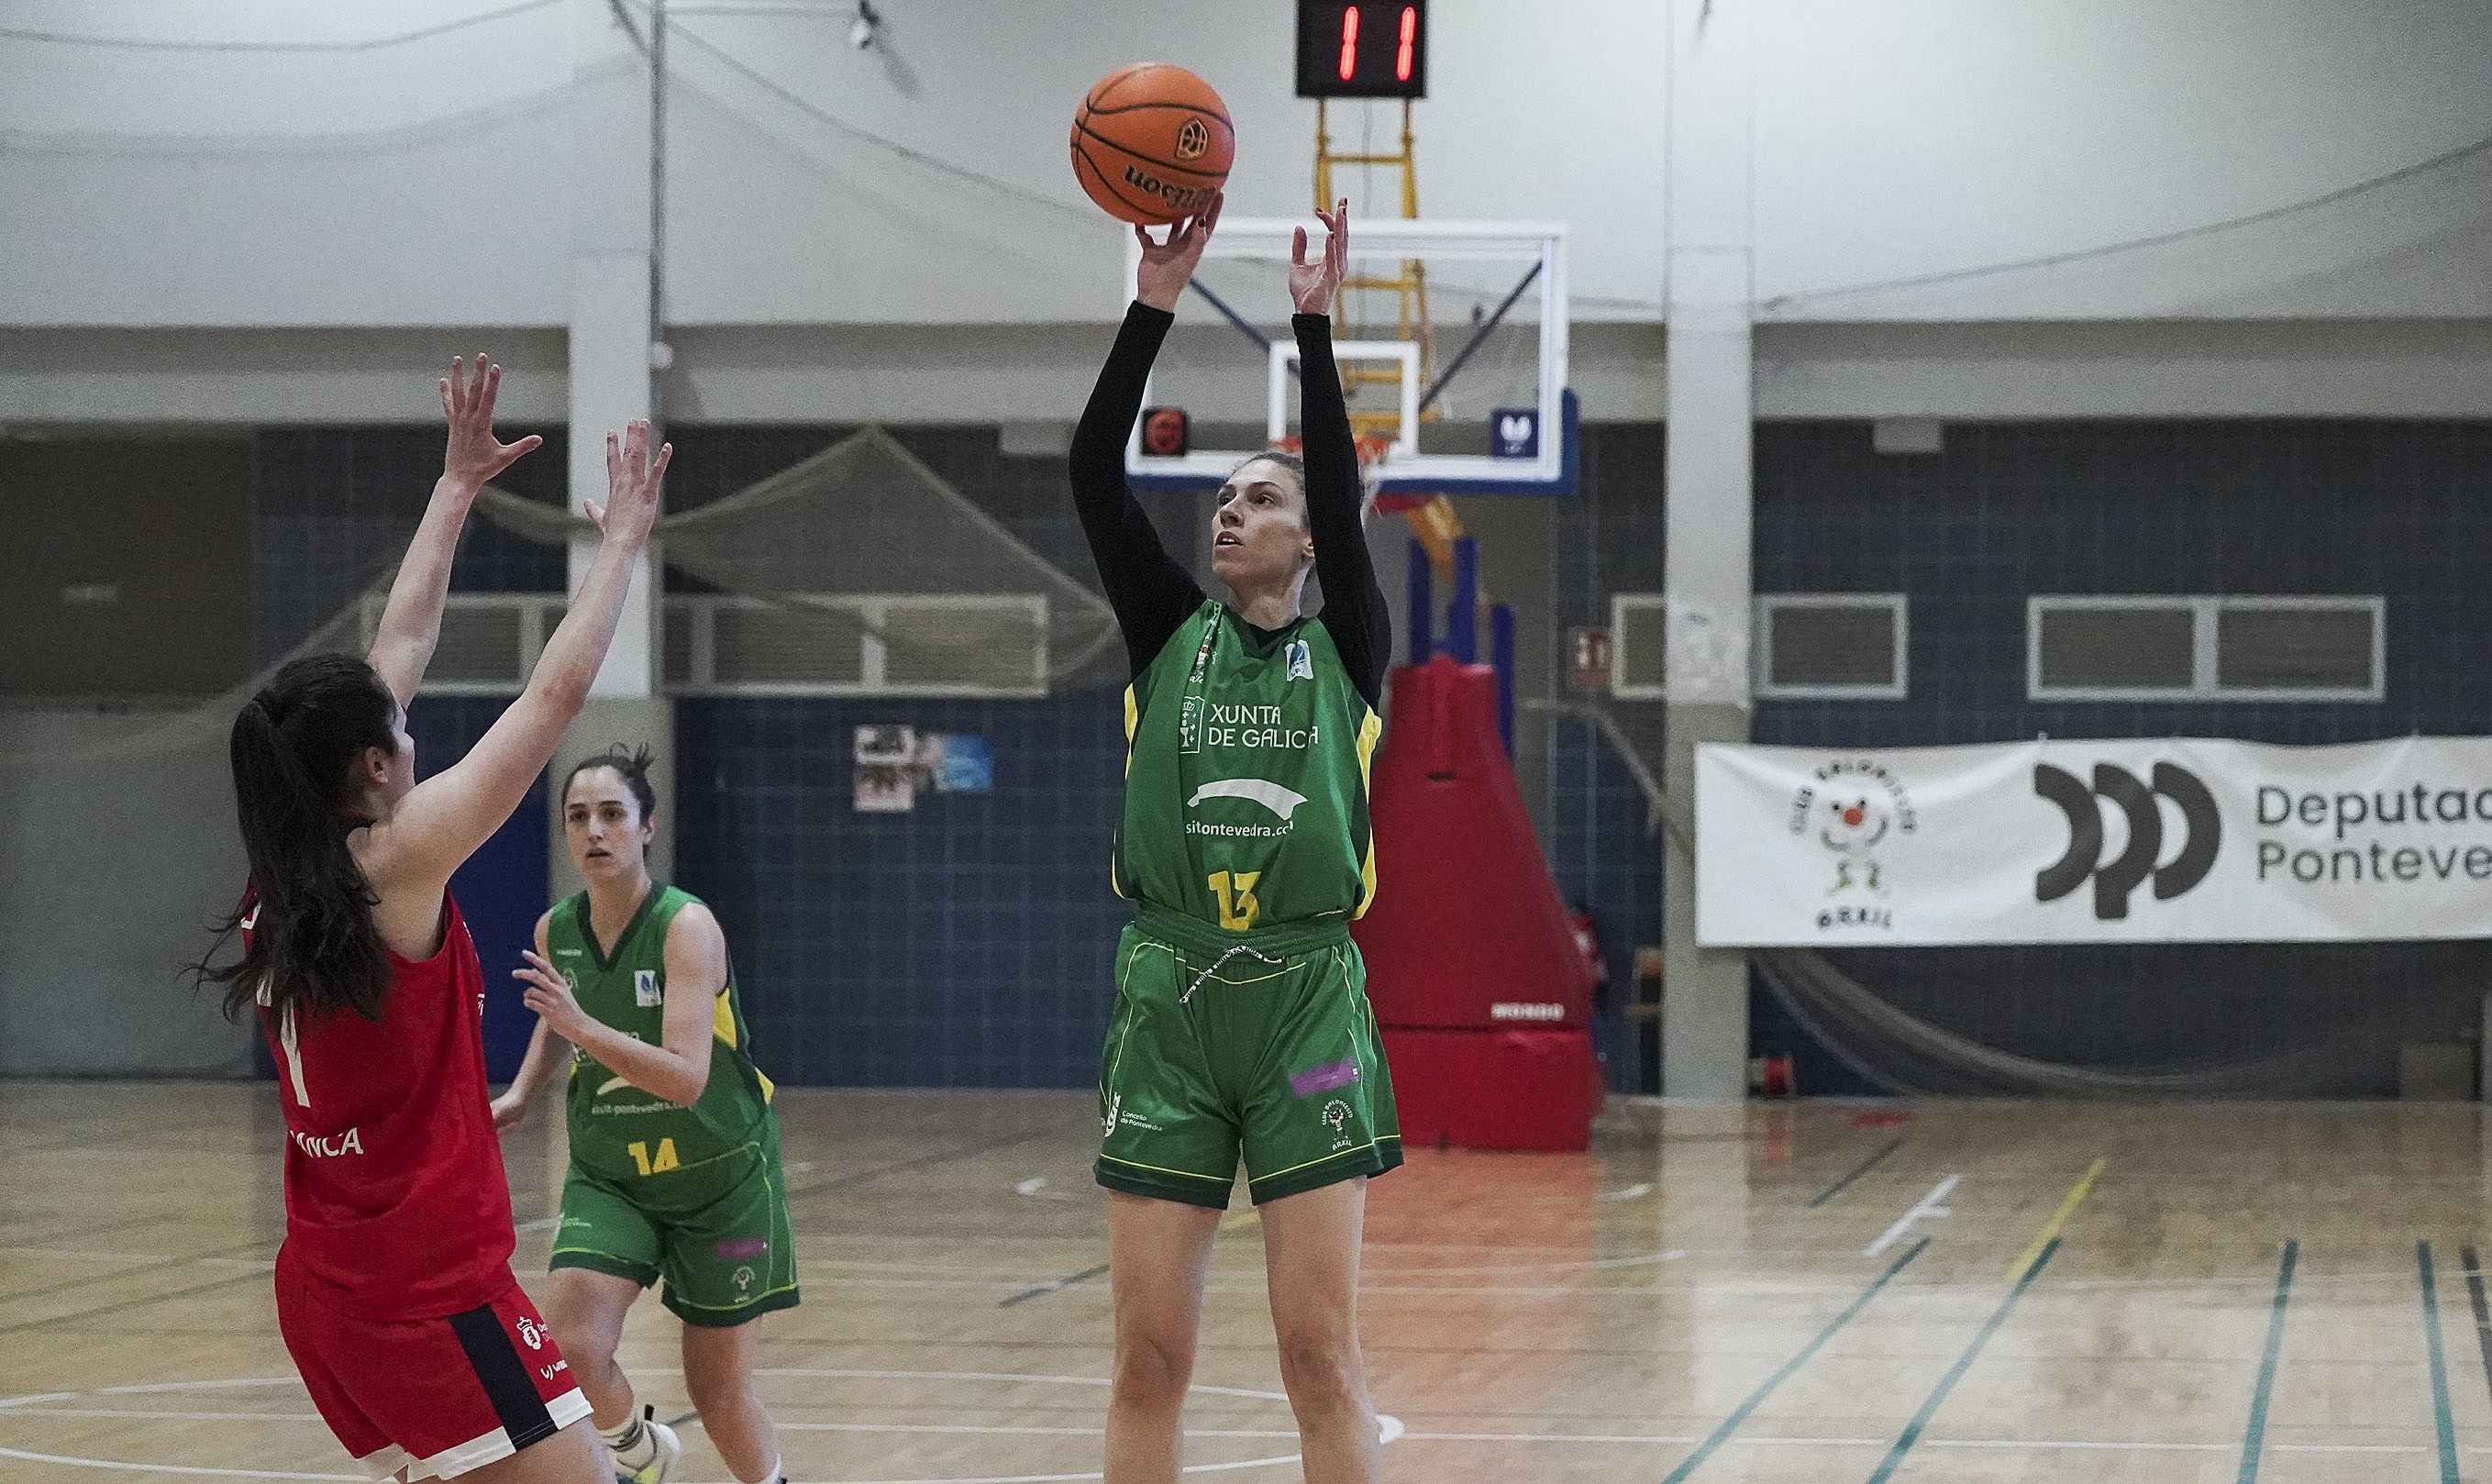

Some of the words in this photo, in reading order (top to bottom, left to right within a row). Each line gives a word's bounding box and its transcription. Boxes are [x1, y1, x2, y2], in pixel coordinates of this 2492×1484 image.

[1338, 6, 1416, 82] 11
[1210, 704, 1281, 725] XUNTA
[1208, 727, 1236, 747] DE
[2258, 840, 2492, 881] Ponteve
[1208, 870, 1261, 931] 13
[627, 1137, 680, 1176] 14
[1332, 1139, 1352, 1151] ARXIL
